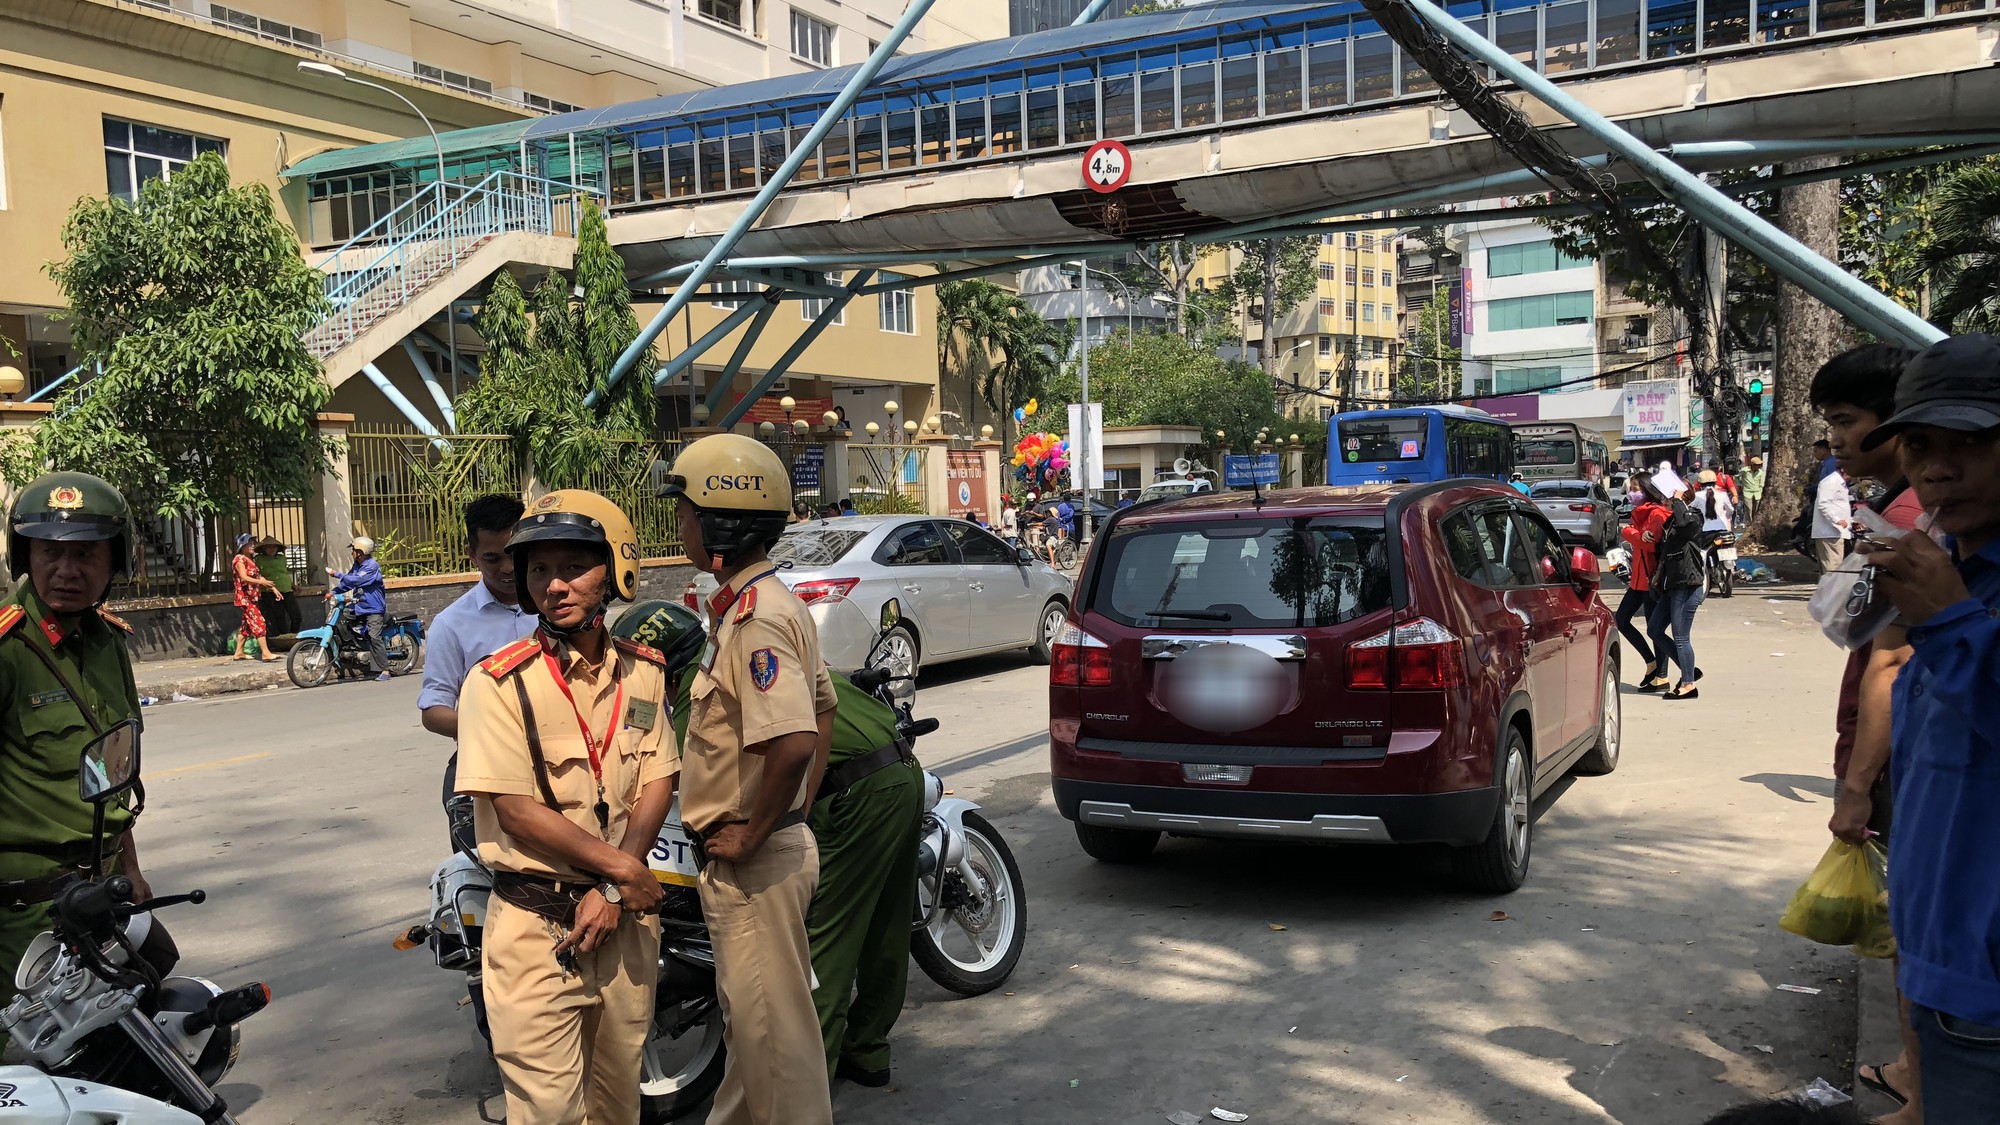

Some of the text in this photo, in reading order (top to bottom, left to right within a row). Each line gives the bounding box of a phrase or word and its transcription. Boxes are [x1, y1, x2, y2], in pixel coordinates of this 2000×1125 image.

[1092, 157, 1120, 176] 4,8m
[1451, 308, 1459, 338] TPBank
[1349, 439, 1358, 449] 02
[1404, 445, 1416, 453] 02
[705, 475, 764, 491] CSGT
[631, 607, 674, 646] CSTT
[1086, 712, 1129, 721] CHEVROLET
[1315, 720, 1364, 728] ORLANDO
